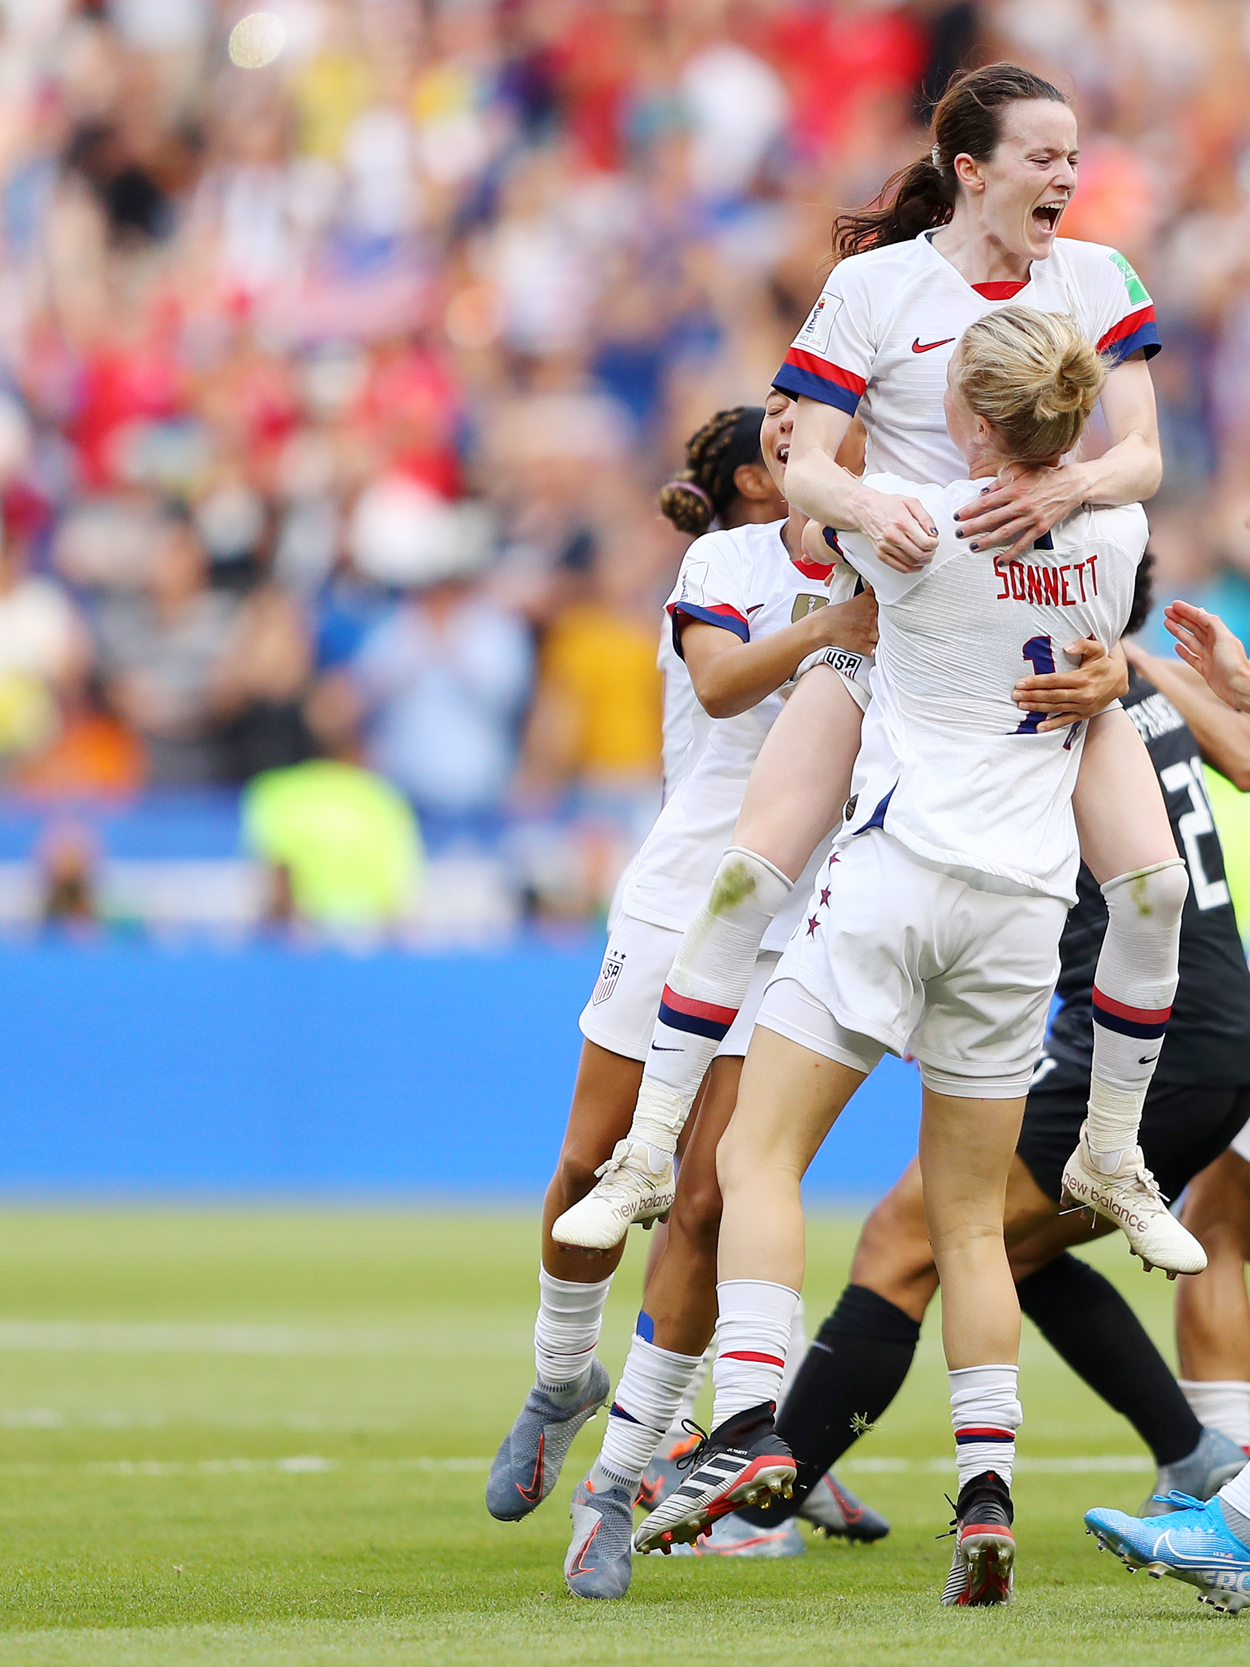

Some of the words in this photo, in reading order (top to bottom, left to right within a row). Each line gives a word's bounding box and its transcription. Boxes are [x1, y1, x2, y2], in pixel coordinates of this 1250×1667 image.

[993, 555, 1098, 606] SONNETT
[826, 651, 857, 671] USA
[610, 1200, 638, 1221] new
[1063, 1171, 1088, 1195] new
[1090, 1186, 1149, 1233] balance
